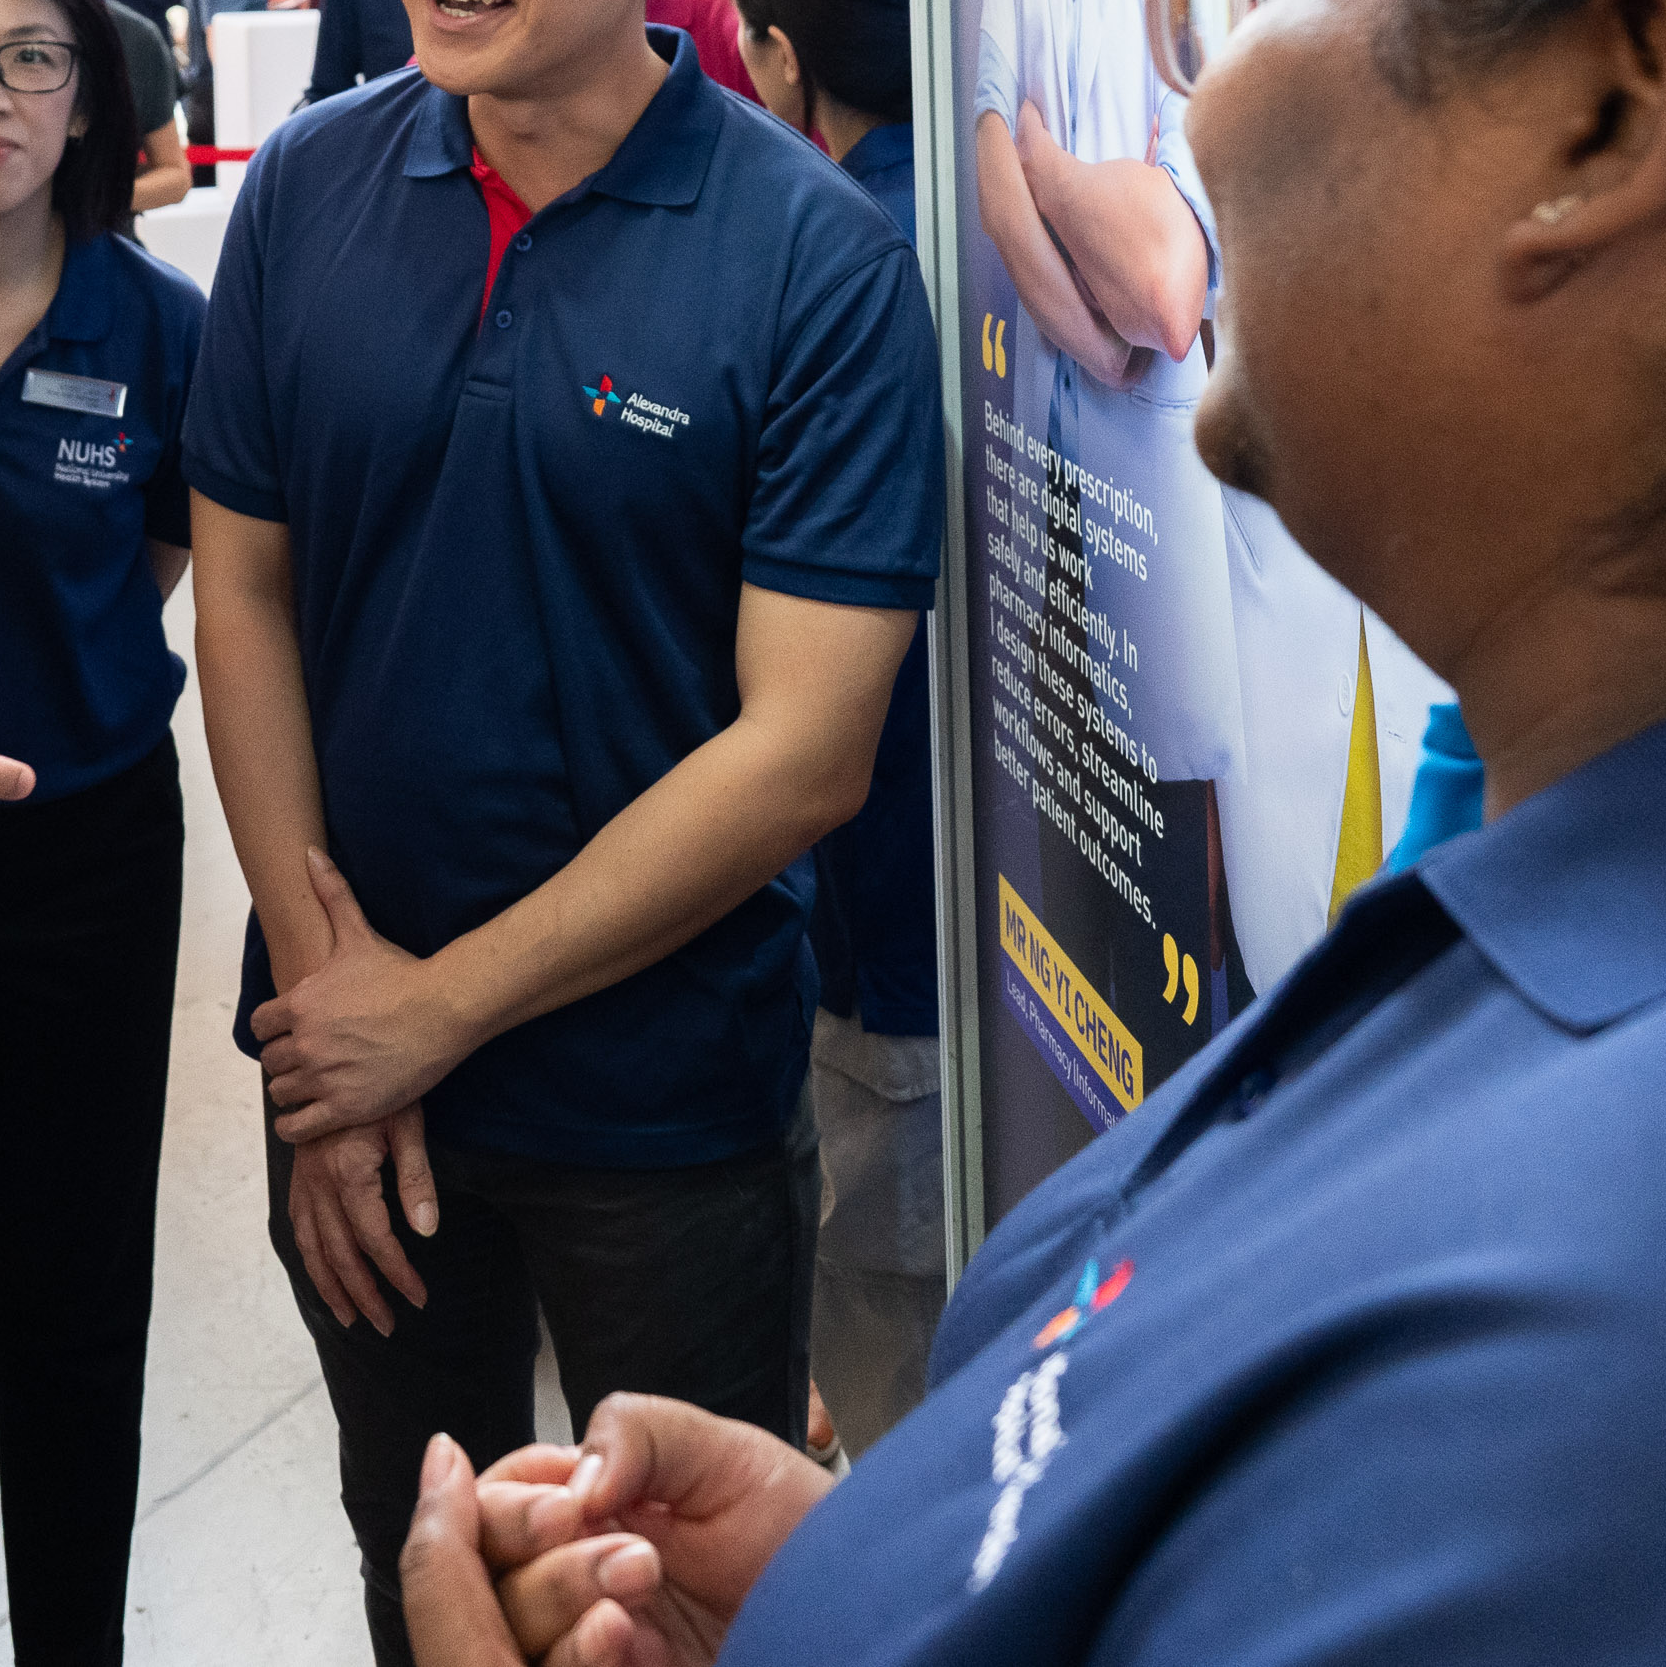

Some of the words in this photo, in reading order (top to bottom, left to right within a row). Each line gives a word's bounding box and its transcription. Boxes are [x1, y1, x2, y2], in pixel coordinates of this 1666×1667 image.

[57, 438, 117, 468] NUHS
[620, 407, 675, 438] Hospital
[626, 392, 691, 426] Alexandra
[984, 400, 1025, 454] Behind
[1027, 434, 1061, 484] every
[1064, 457, 1159, 547] prescription,
[985, 444, 1016, 490] there
[1018, 472, 1039, 506] are
[1041, 483, 1083, 538] digital
[1085, 517, 1148, 582] systems
[986, 485, 1010, 522] that
[1012, 501, 1038, 551] help
[1041, 532, 1057, 562] us
[1058, 541, 1094, 592] work
[987, 532, 1022, 584] safely
[1023, 560, 1047, 599] and
[1049, 578, 1119, 661] efficiently.
[1123, 628, 1138, 673] In
[989, 571, 1047, 647] pharmacy
[1049, 615, 1133, 722] informatics,
[990, 605, 995, 638] I
[997, 617, 1036, 676] design
[1038, 651, 1074, 710] these
[1077, 688, 1138, 768] systems
[1141, 742, 1159, 786] to
[991, 654, 1032, 713] reduce
[1033, 696, 1079, 764] errors,
[1081, 740, 1164, 840] streamline
[992, 694, 1055, 777] workflows
[1056, 761, 1081, 806] and
[1084, 788, 1143, 869] support
[994, 729, 1030, 792] better
[1032, 776, 1077, 846] patient
[1079, 828, 1157, 931] outcomes.
[1005, 900, 1027, 961] MR
[1029, 931, 1051, 991] NG
[1053, 960, 1072, 1020] YI
[1074, 990, 1135, 1102] CHENG
[1006, 968, 1029, 1021] Lead,
[1029, 1001, 1073, 1081] Pharmacy
